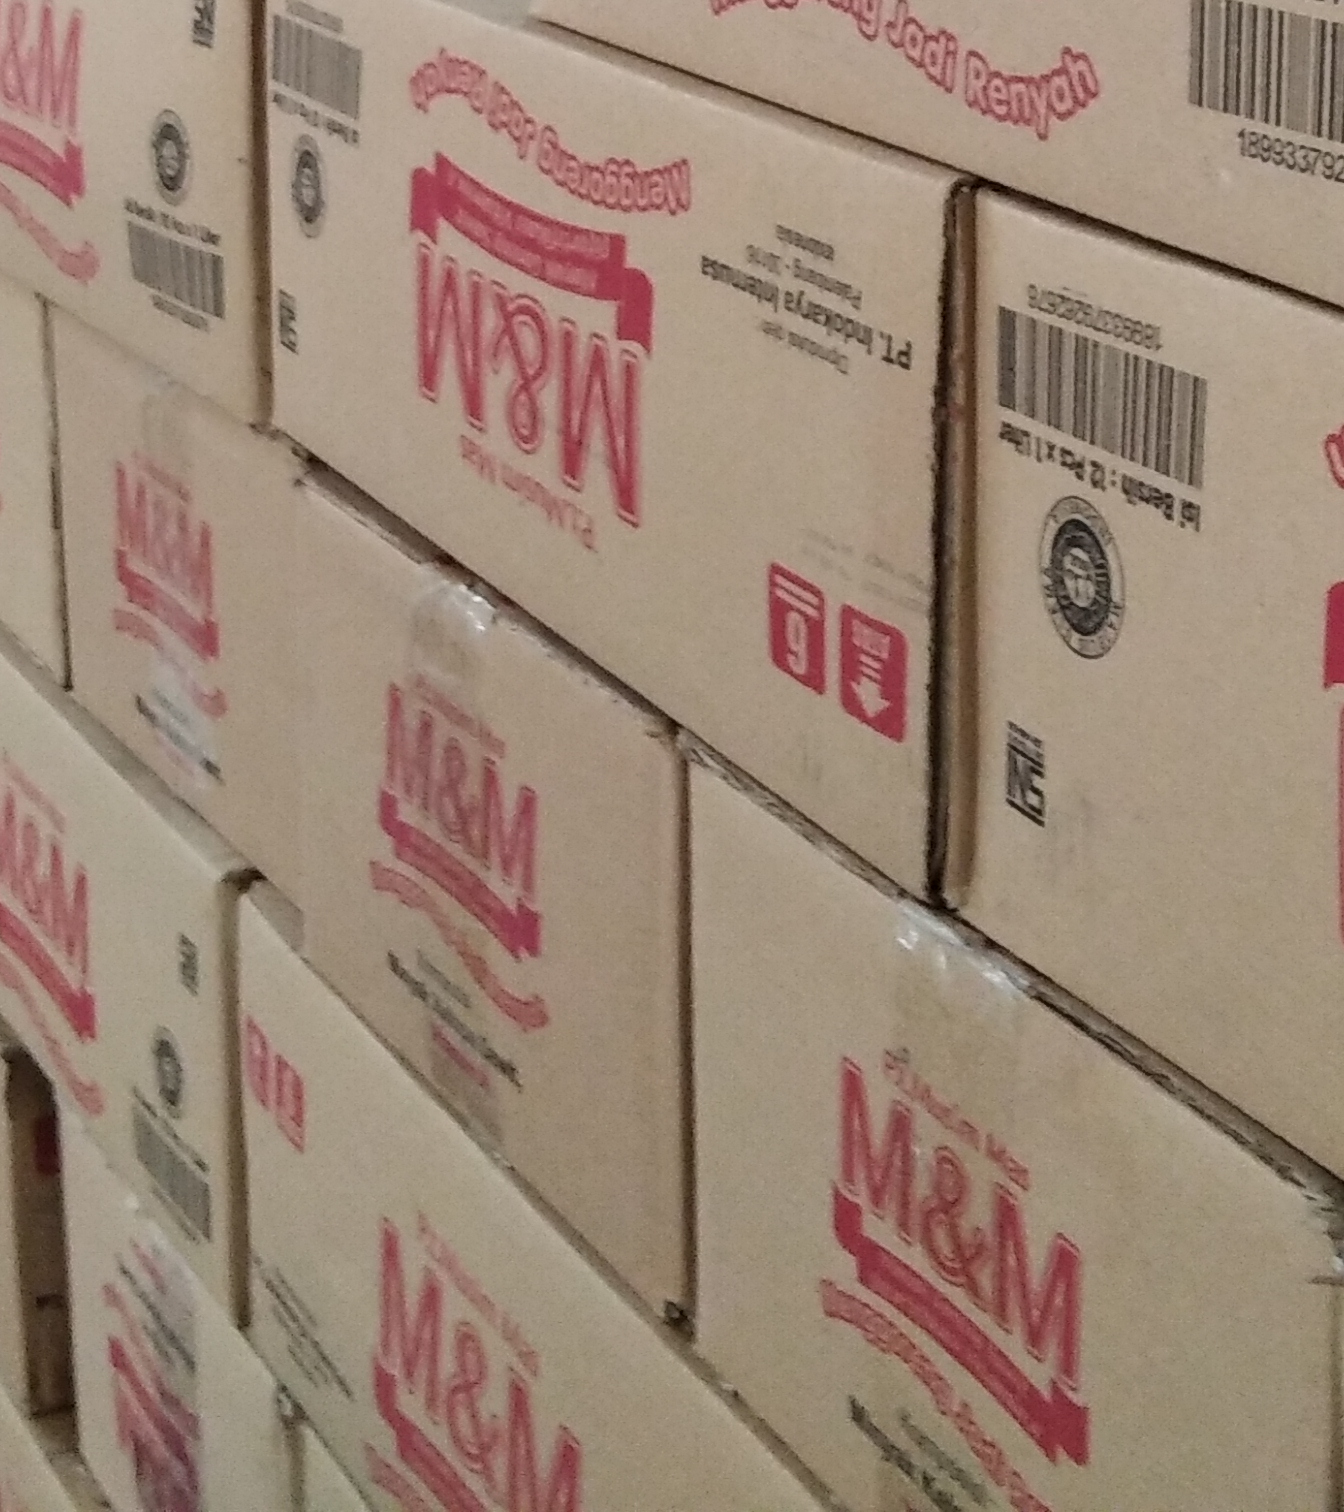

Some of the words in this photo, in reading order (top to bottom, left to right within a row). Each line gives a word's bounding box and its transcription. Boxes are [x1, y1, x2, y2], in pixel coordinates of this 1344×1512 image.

[965, 45, 1099, 142] Renyah
[415, 240, 644, 529] M&M
[385, 681, 539, 900] M&M
[838, 1054, 1082, 1393] M&M
